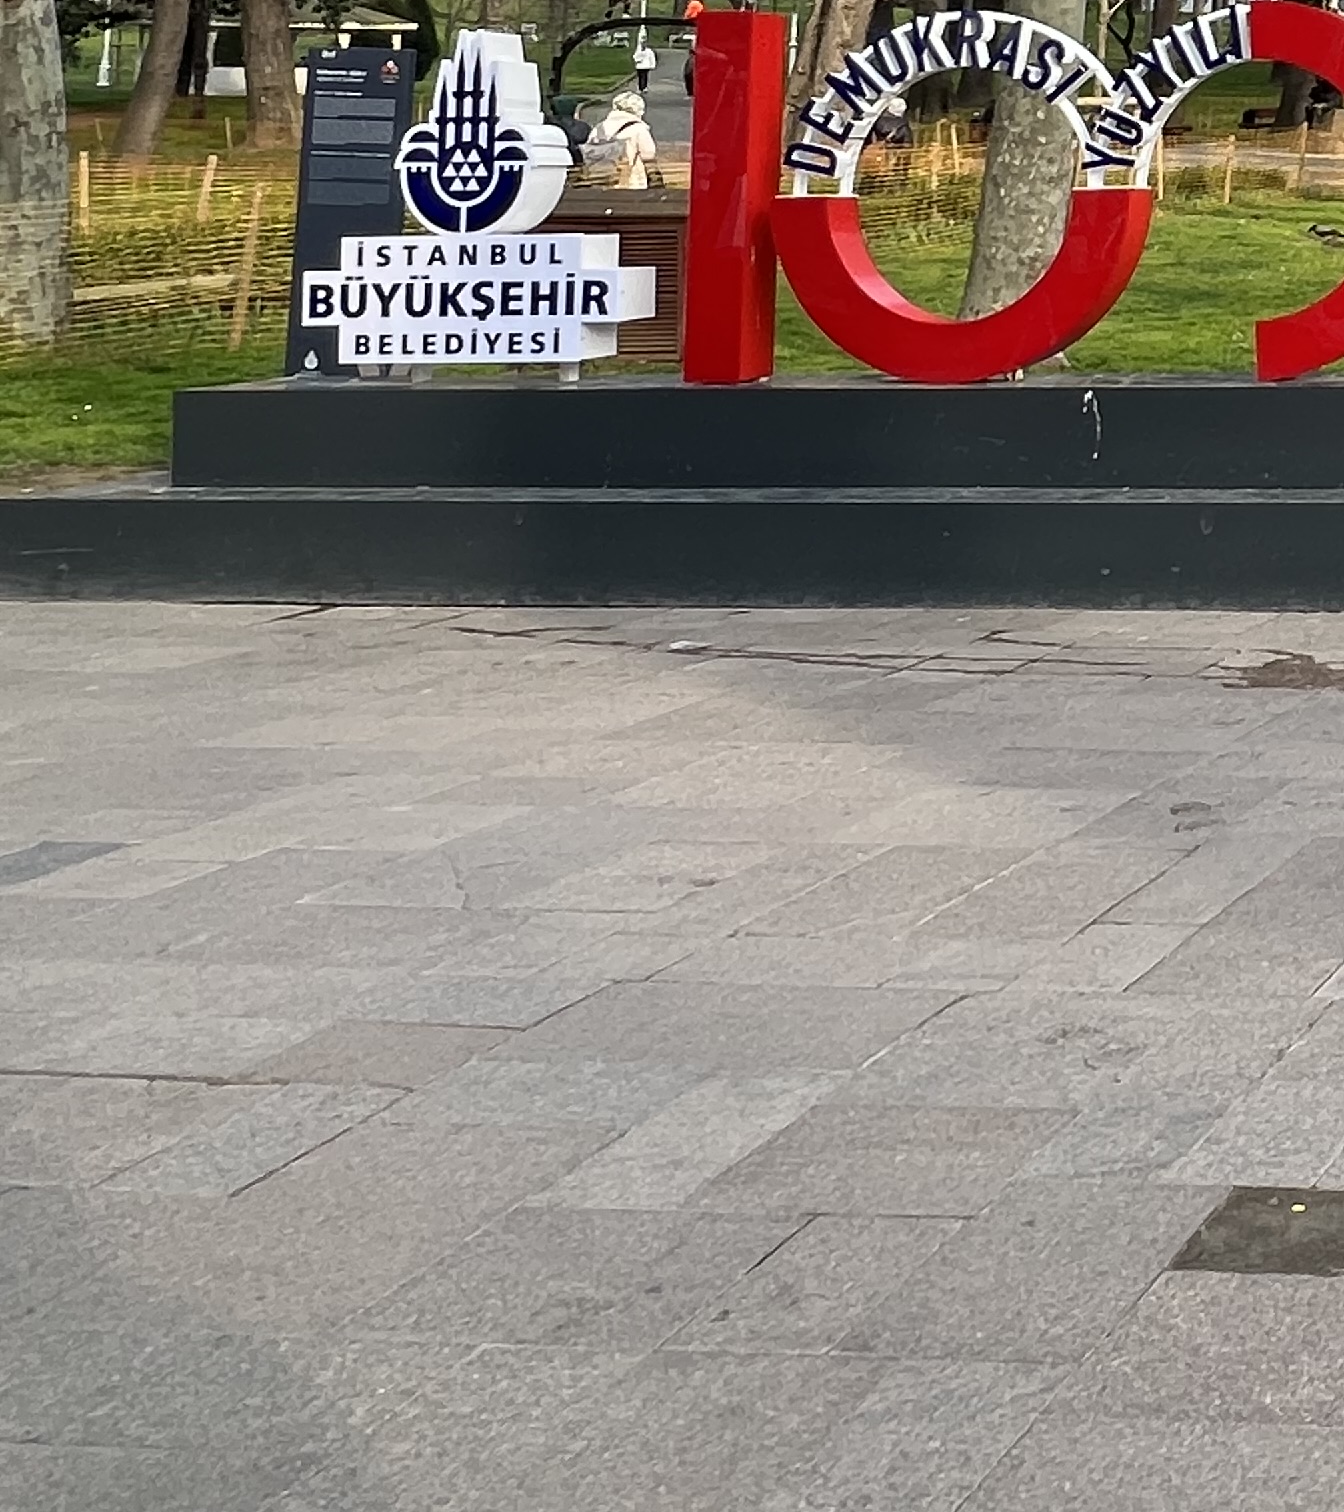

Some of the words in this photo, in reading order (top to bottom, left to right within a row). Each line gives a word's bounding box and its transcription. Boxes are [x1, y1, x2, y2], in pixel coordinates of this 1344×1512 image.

[356, 240, 563, 268] İSTANBUL
[308, 273, 610, 321] BÜYÜKŞEHİR
[354, 328, 562, 356] BELEDİYESİ
